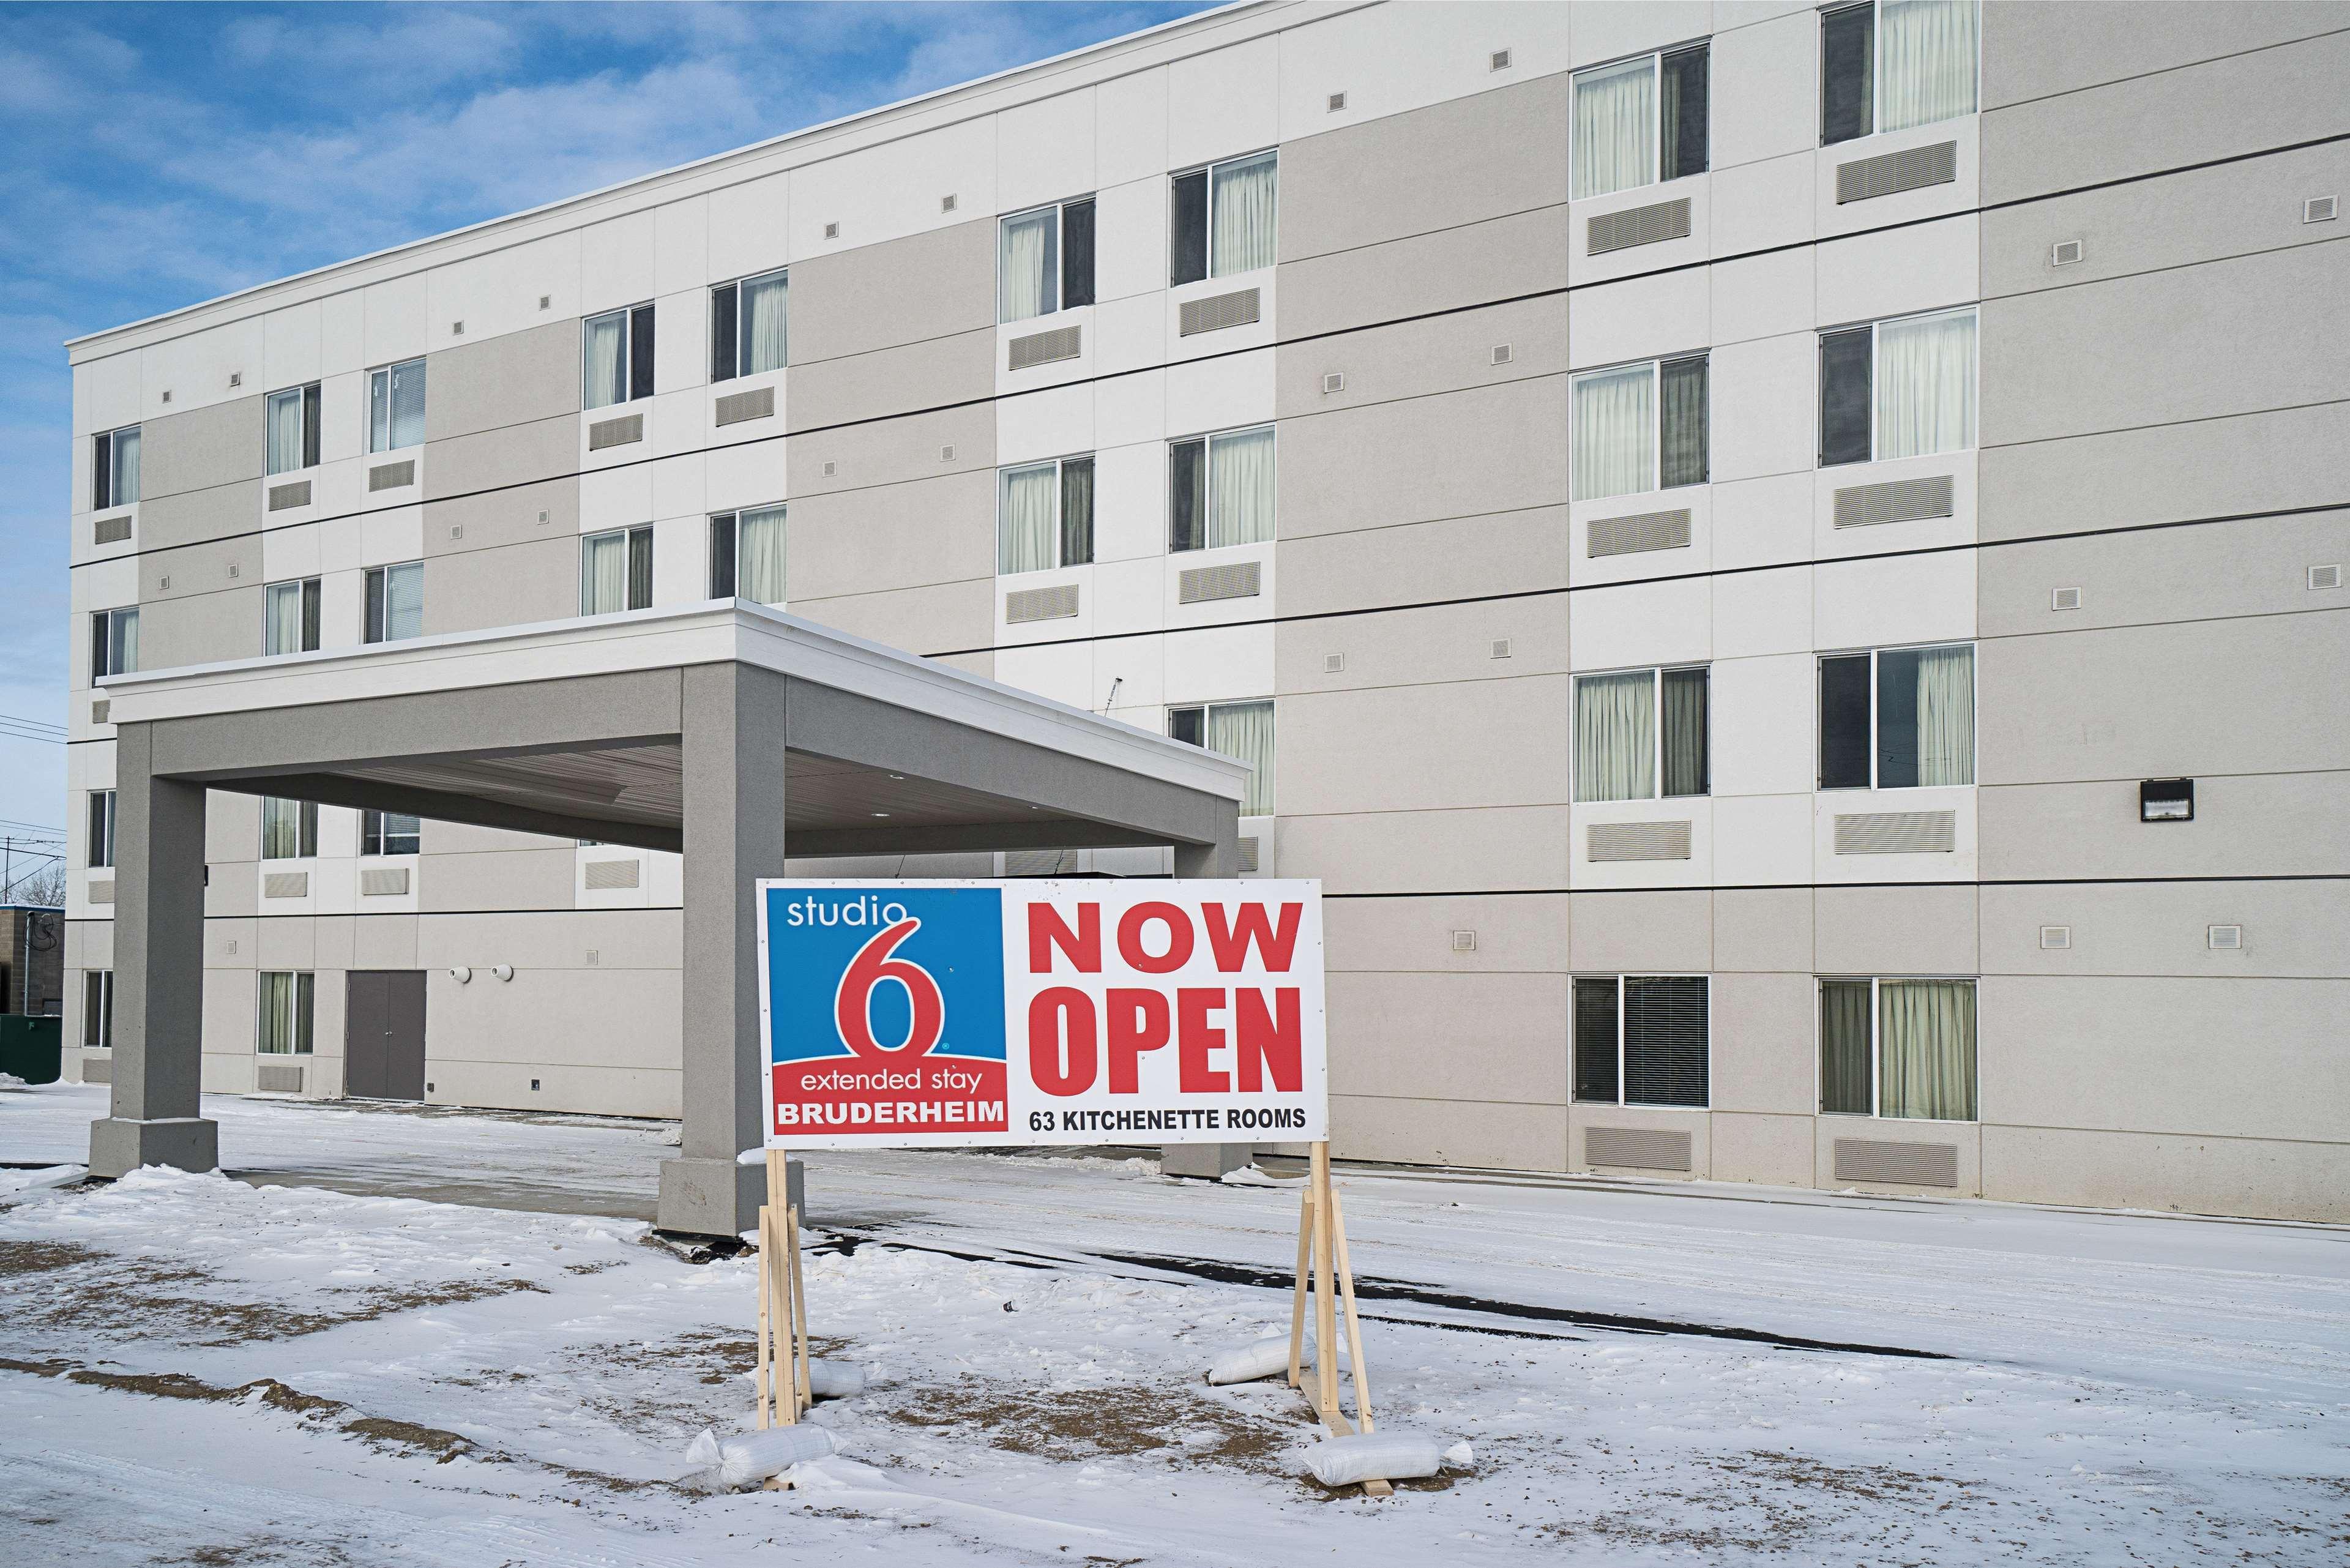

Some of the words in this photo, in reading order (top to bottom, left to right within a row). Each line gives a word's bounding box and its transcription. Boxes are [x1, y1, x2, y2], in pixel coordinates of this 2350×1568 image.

[786, 895, 907, 927] studio
[1028, 902, 1303, 974] NOW
[834, 916, 945, 1058] 6
[1028, 986, 1302, 1097] OPEN
[800, 1068, 921, 1091] extended
[931, 1069, 983, 1094] stay
[777, 1100, 1004, 1125] BRUDERHEIM
[1029, 1111, 1055, 1132] 63
[1063, 1110, 1220, 1132] KITCHENETTE
[1227, 1108, 1307, 1129] ROOMS
